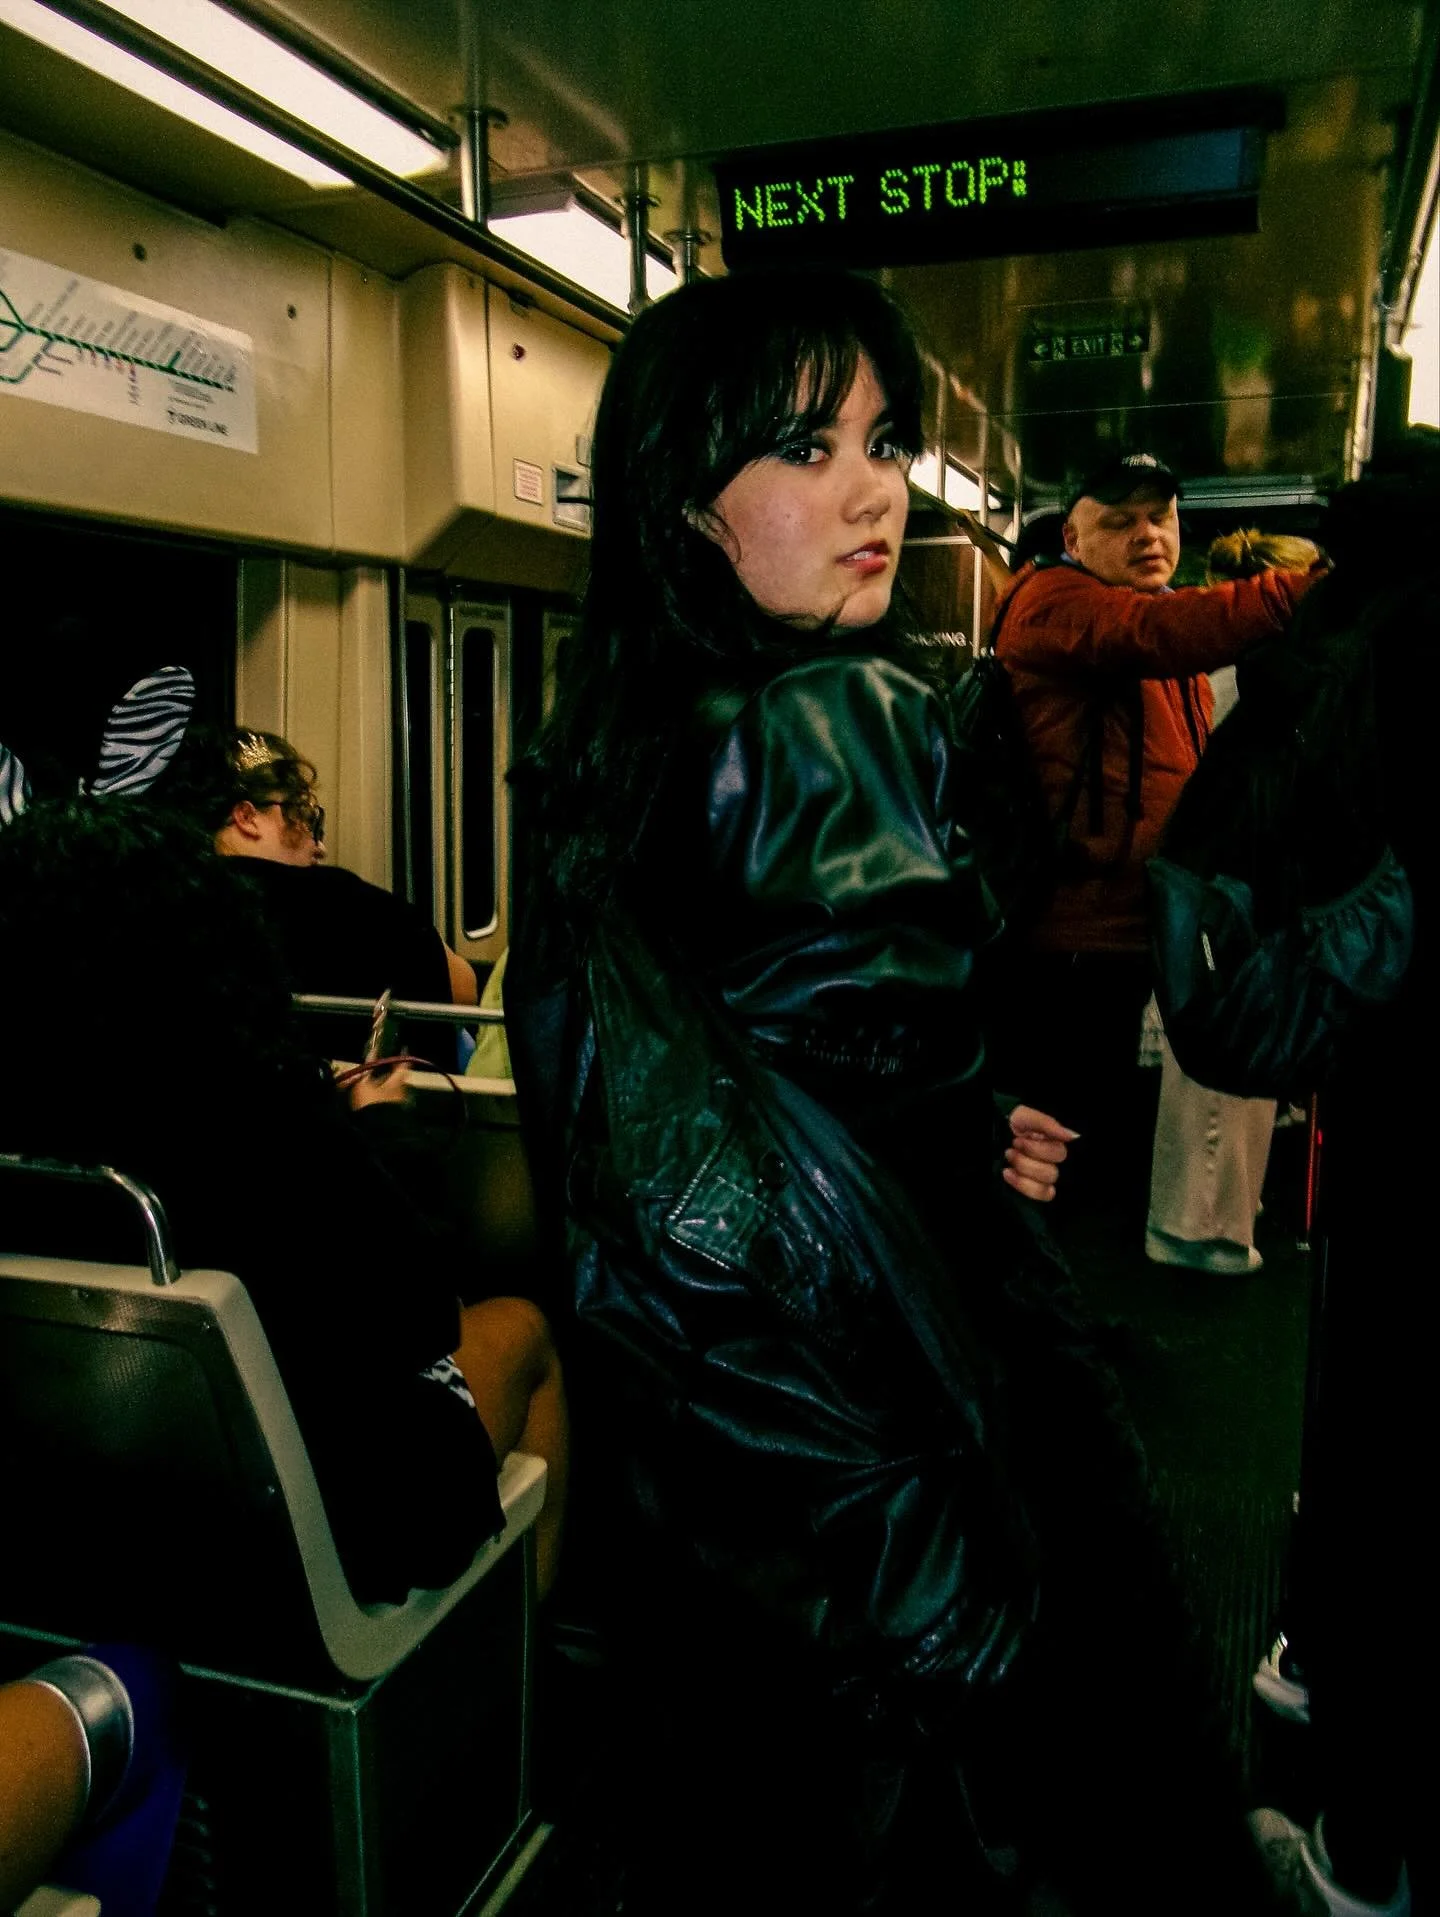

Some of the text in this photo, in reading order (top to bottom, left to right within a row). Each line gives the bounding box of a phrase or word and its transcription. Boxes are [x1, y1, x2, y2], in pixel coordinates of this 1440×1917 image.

[735, 157, 1026, 230] NEXT STOP:
[1072, 335, 1105, 355] EXIT
